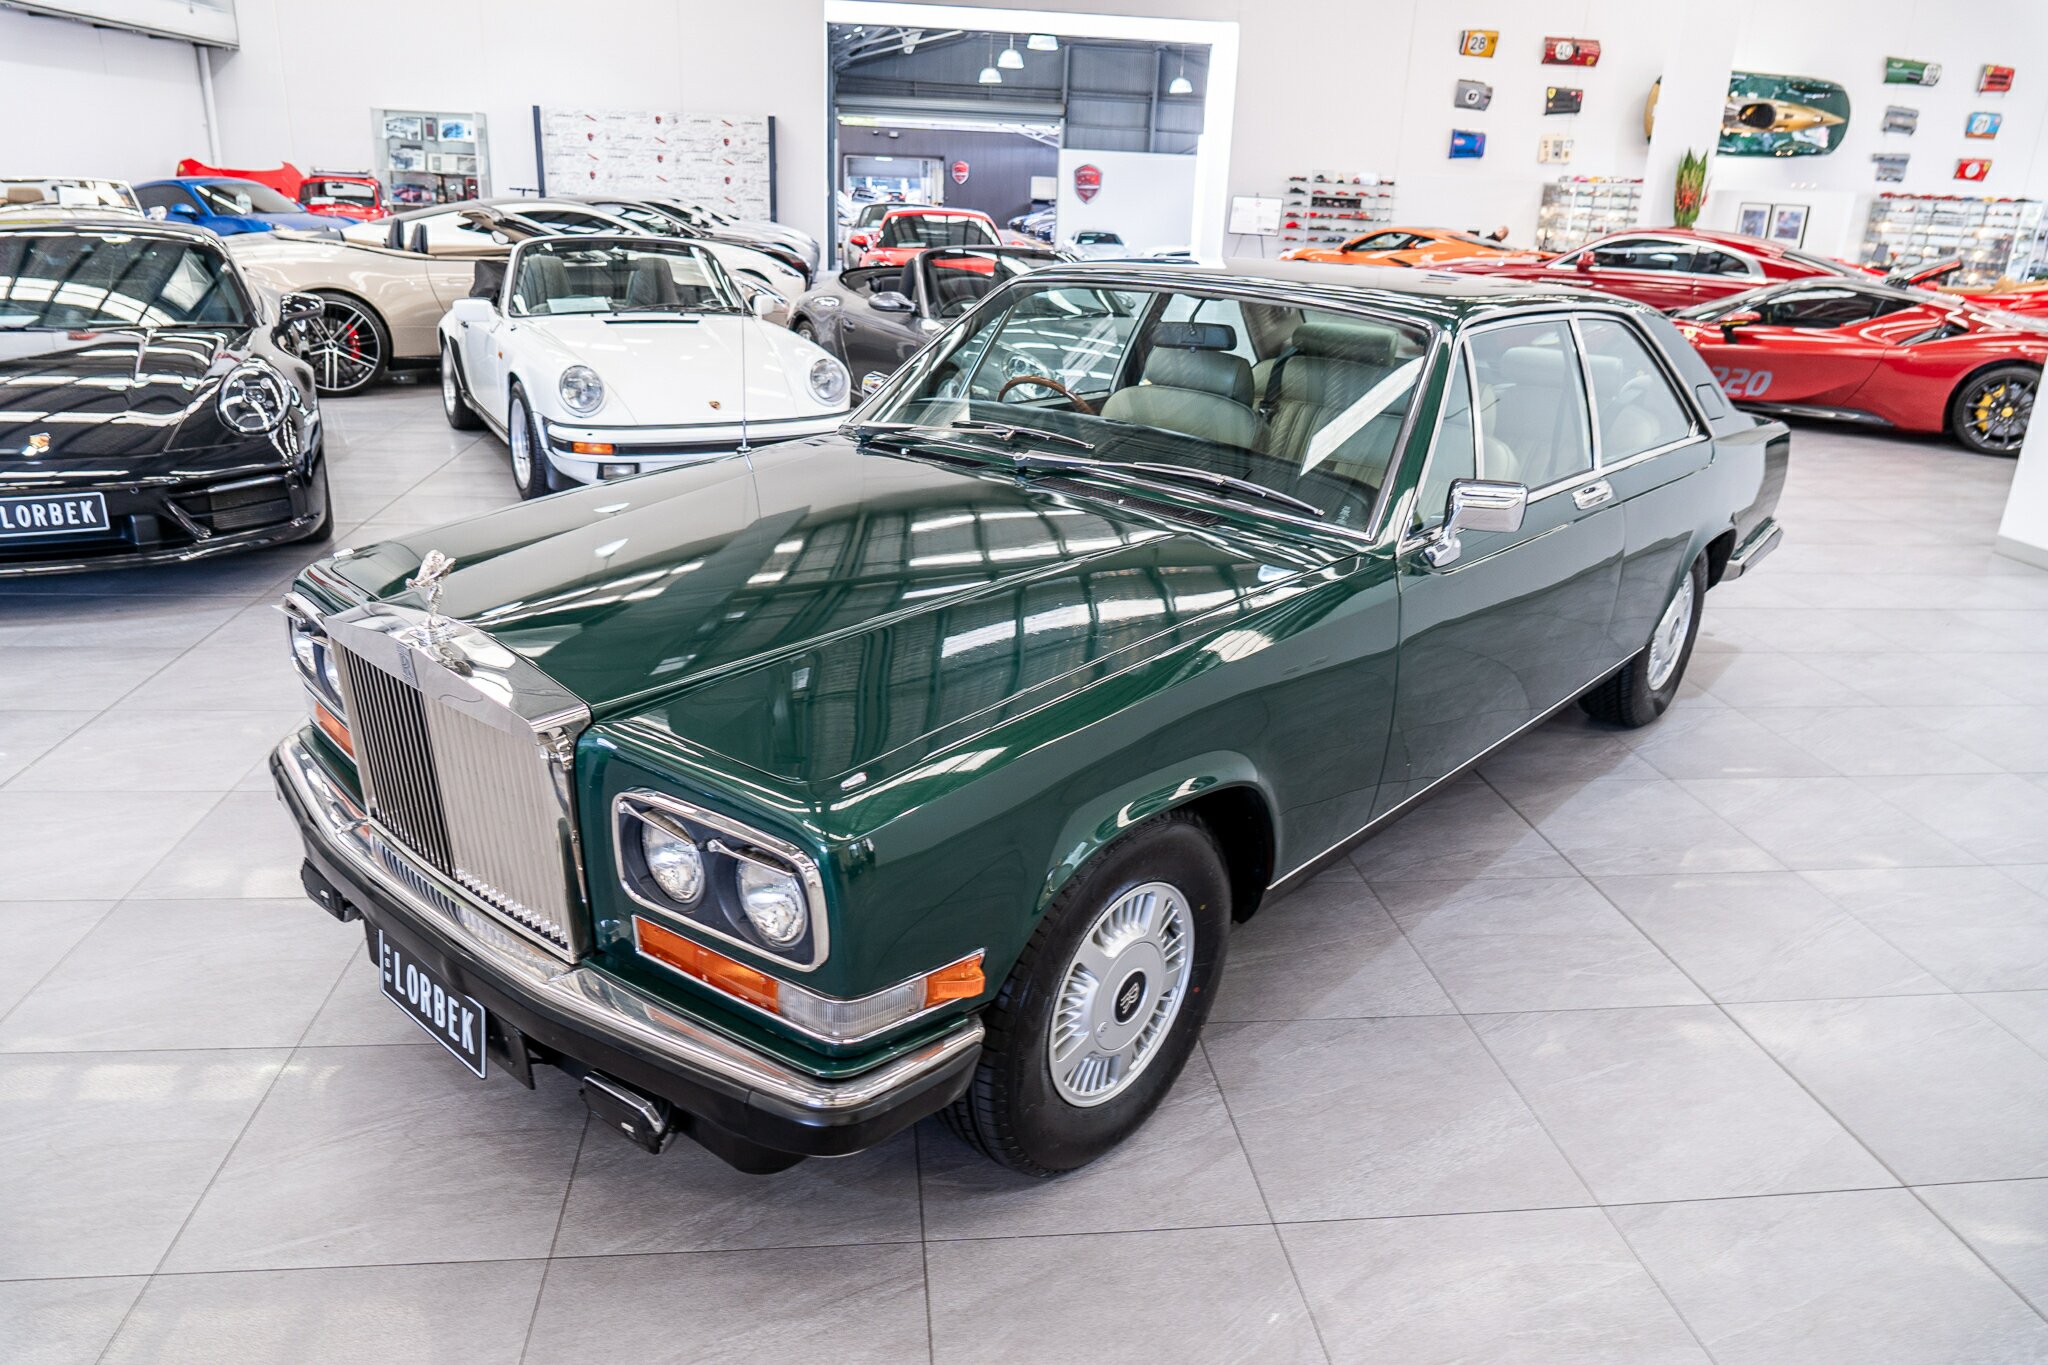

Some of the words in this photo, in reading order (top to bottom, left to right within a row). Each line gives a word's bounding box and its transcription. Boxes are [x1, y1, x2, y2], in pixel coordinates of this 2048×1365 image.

[1470, 36, 1486, 50] 28
[0, 500, 97, 529] LORBEK
[394, 951, 476, 1056] LORBEK
